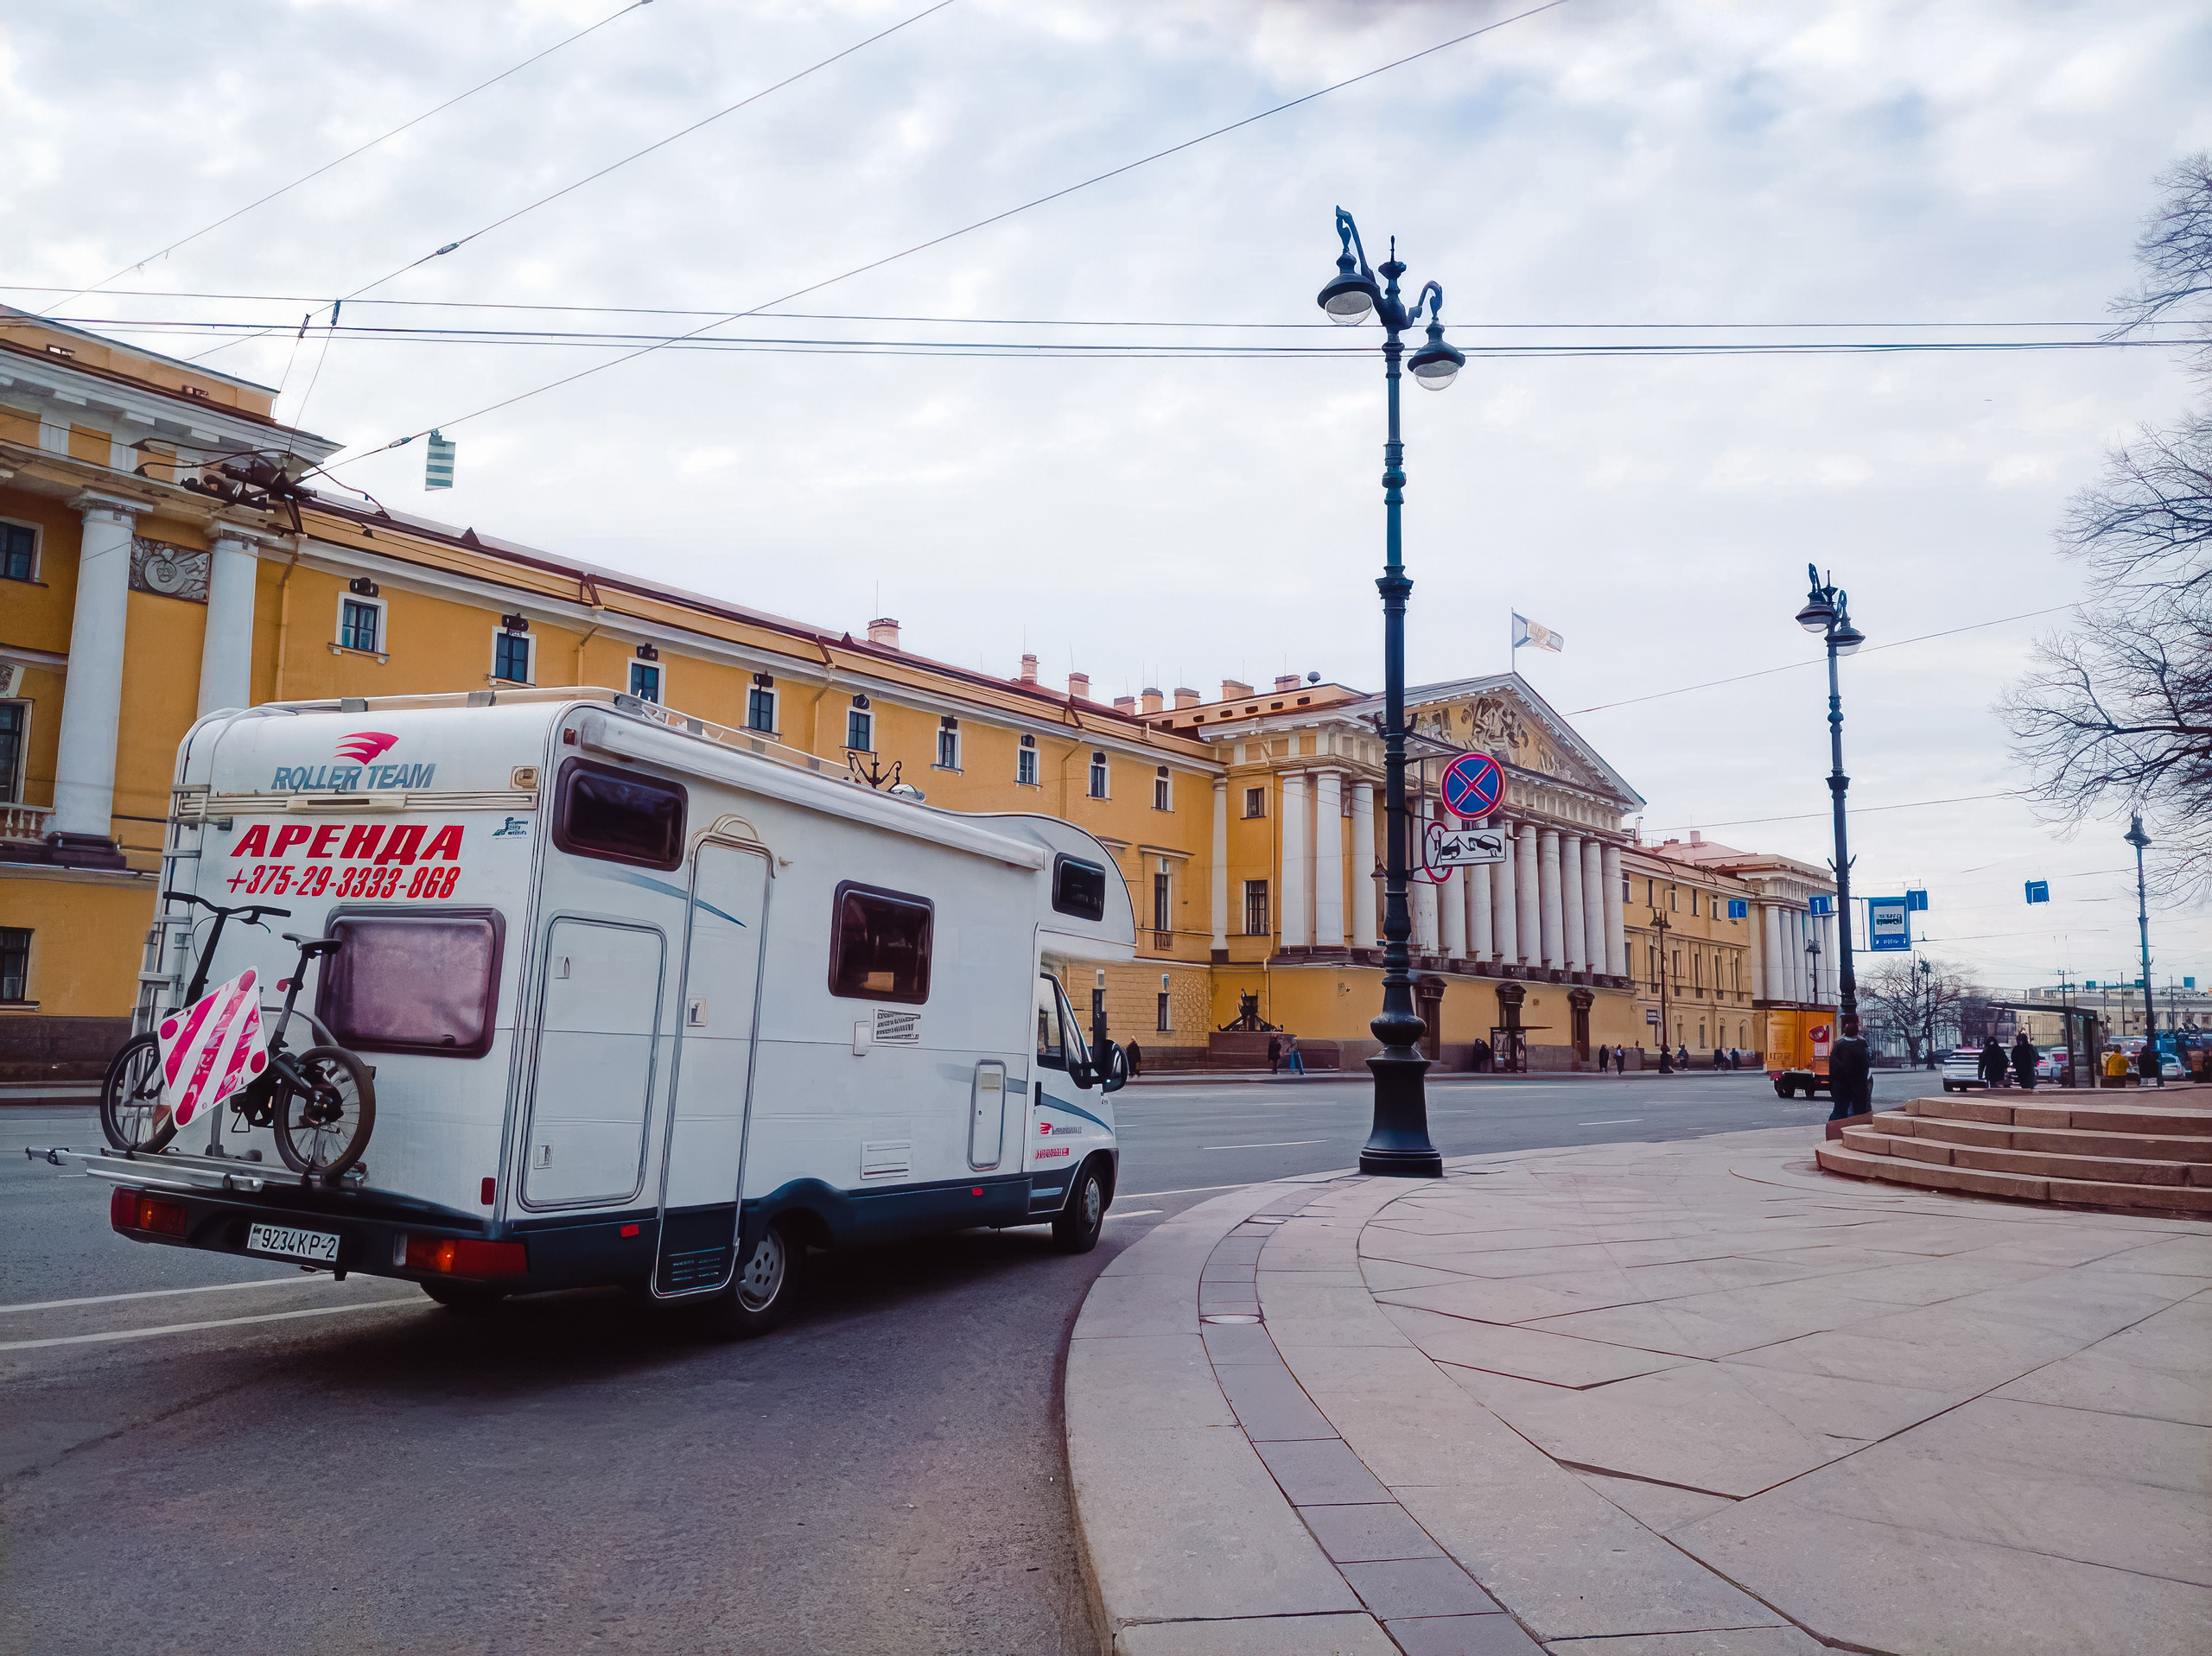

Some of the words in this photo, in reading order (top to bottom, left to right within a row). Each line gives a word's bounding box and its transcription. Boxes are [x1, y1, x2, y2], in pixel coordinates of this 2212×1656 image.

[270, 765, 362, 790] ROLLER
[367, 764, 436, 790] TEAM
[230, 824, 465, 866] АРЕНДА
[226, 865, 461, 898] +375-29-3333-868
